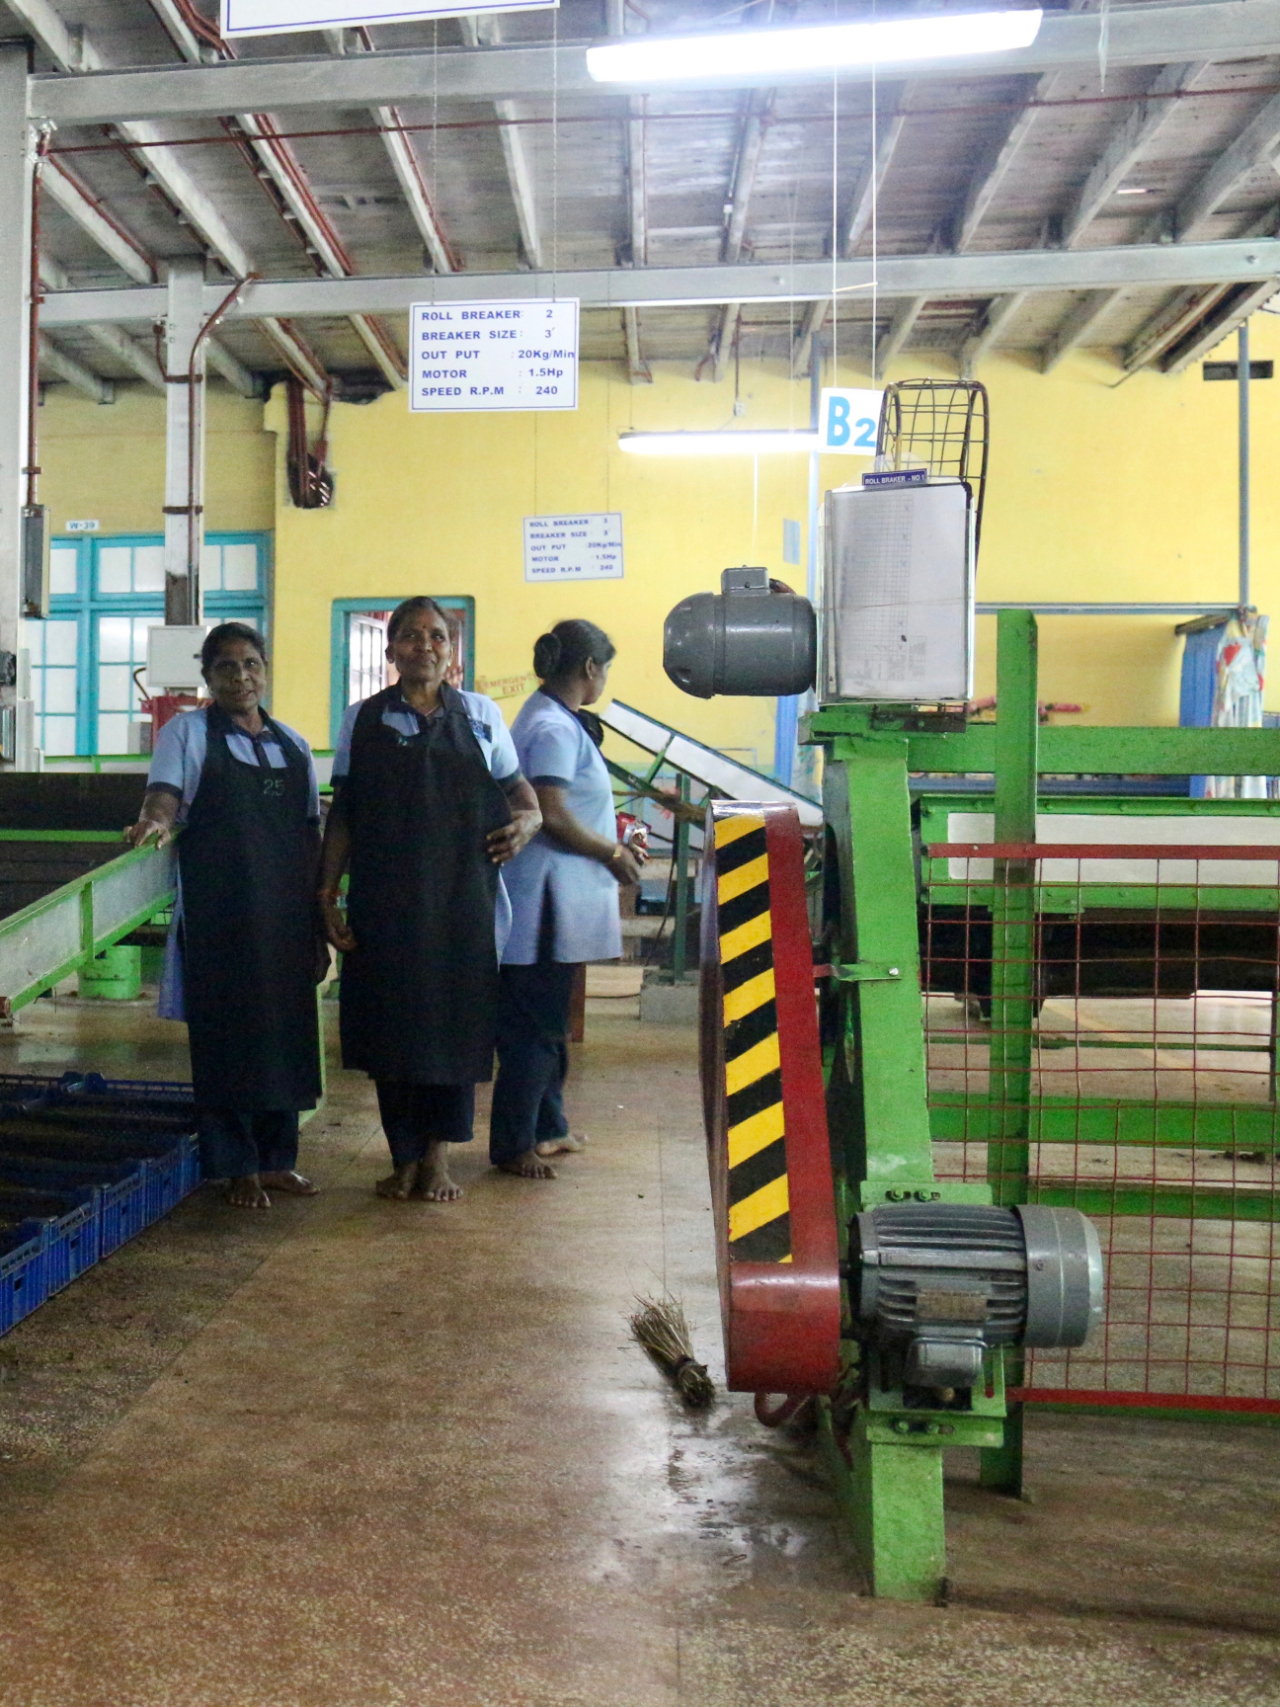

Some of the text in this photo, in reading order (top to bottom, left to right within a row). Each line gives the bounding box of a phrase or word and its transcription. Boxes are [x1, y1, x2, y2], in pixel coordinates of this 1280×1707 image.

[421, 312, 453, 321] ROLL
[546, 309, 553, 319] 2
[421, 331, 481, 341] BREAKER
[421, 350, 447, 360] OUT
[455, 350, 480, 359] PUT
[518, 349, 575, 360] 20Kg/Min
[422, 370, 467, 379] MOTOR
[528, 368, 563, 378] 1.5Hp
[421, 387, 462, 396] SPEED
[470, 386, 504, 395] R.P.M
[535, 386, 558, 395] 240
[826, 396, 877, 448] B2
[881, 475, 906, 484] BRAKER
